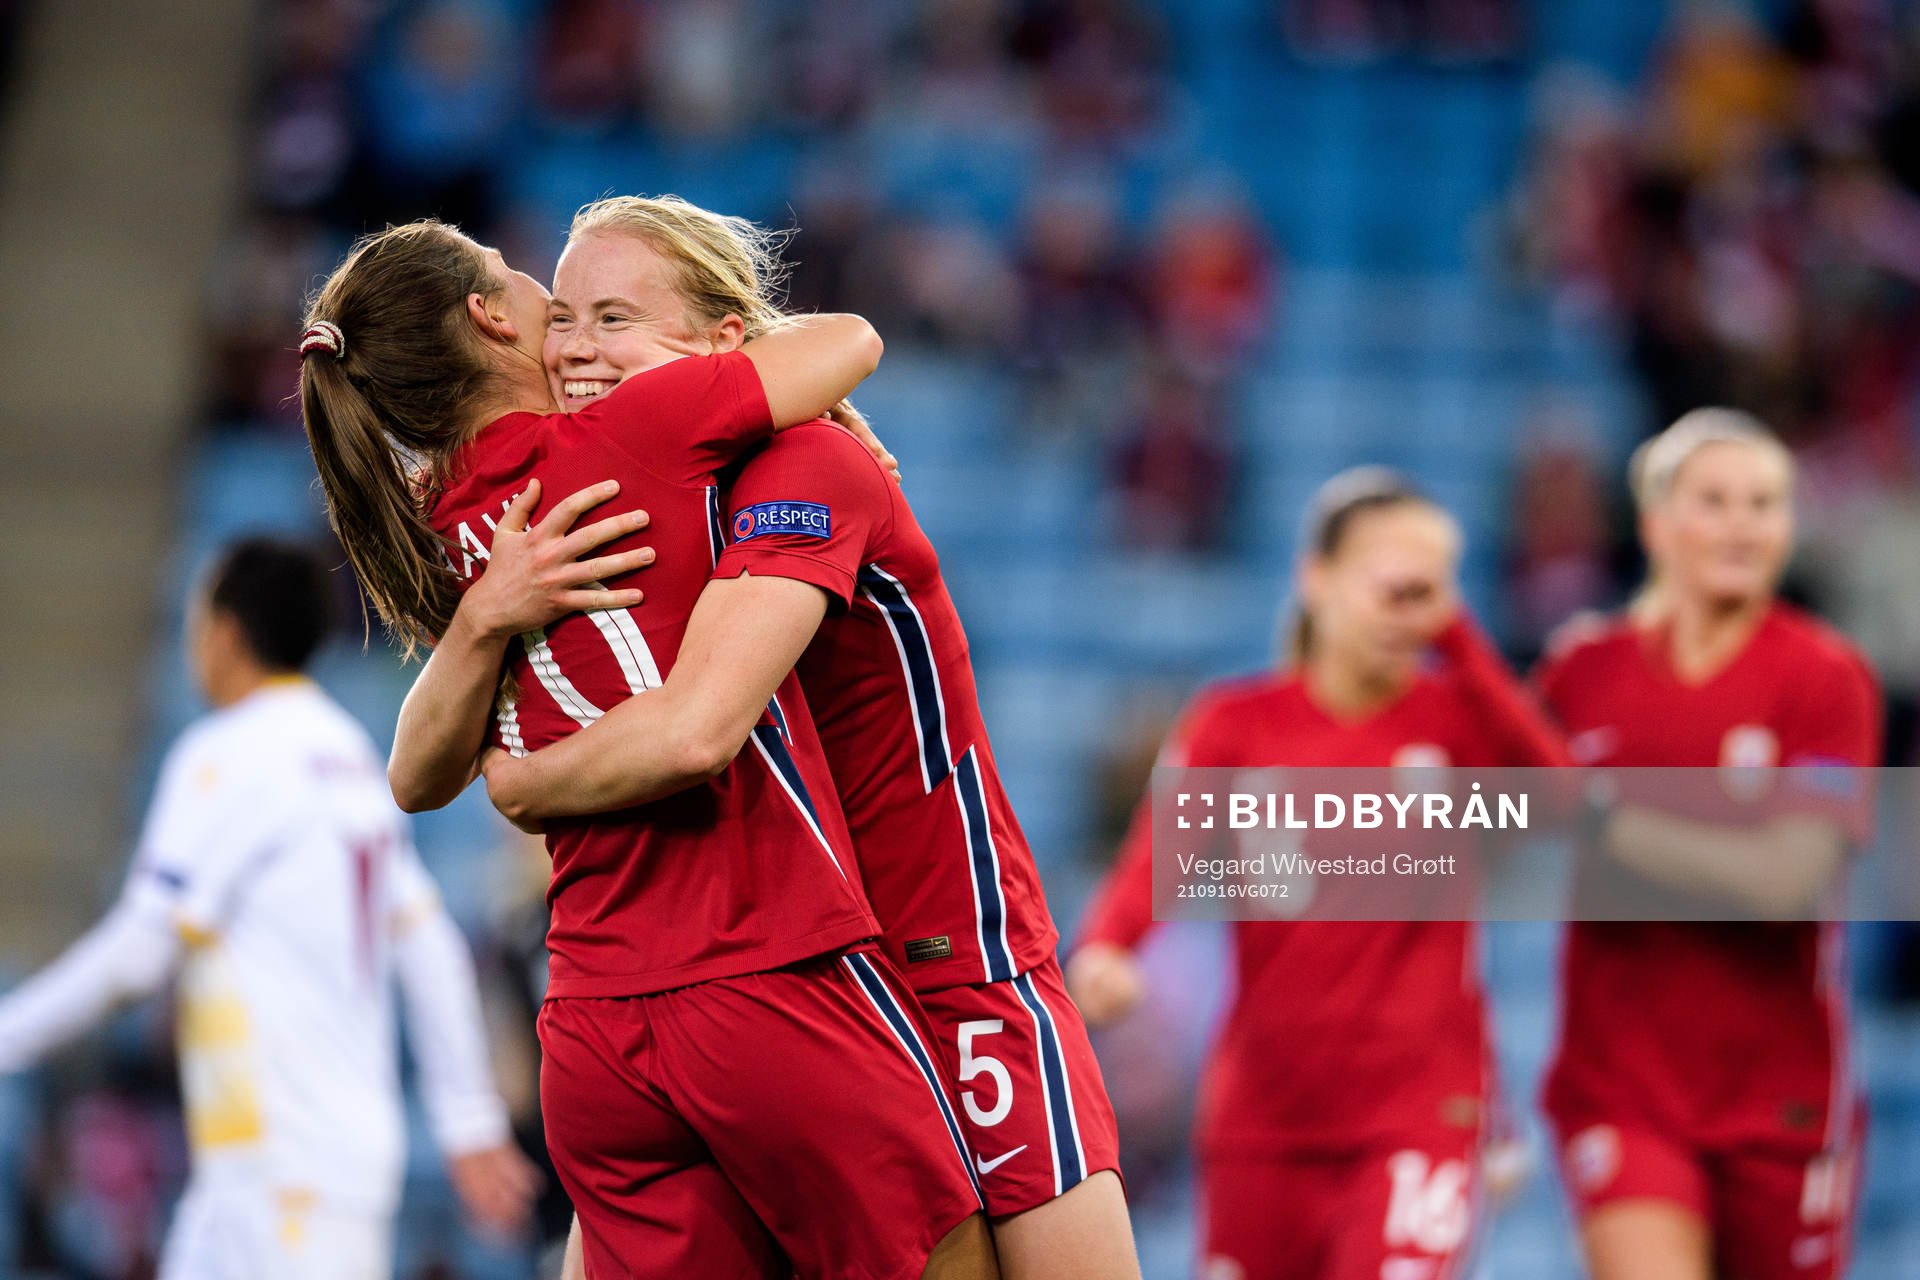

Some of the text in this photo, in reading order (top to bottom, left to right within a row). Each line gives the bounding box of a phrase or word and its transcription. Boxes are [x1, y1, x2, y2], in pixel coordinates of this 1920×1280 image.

[758, 510, 829, 529] RESPECT
[957, 1019, 1014, 1127] 5
[1384, 1149, 1470, 1252] 16
